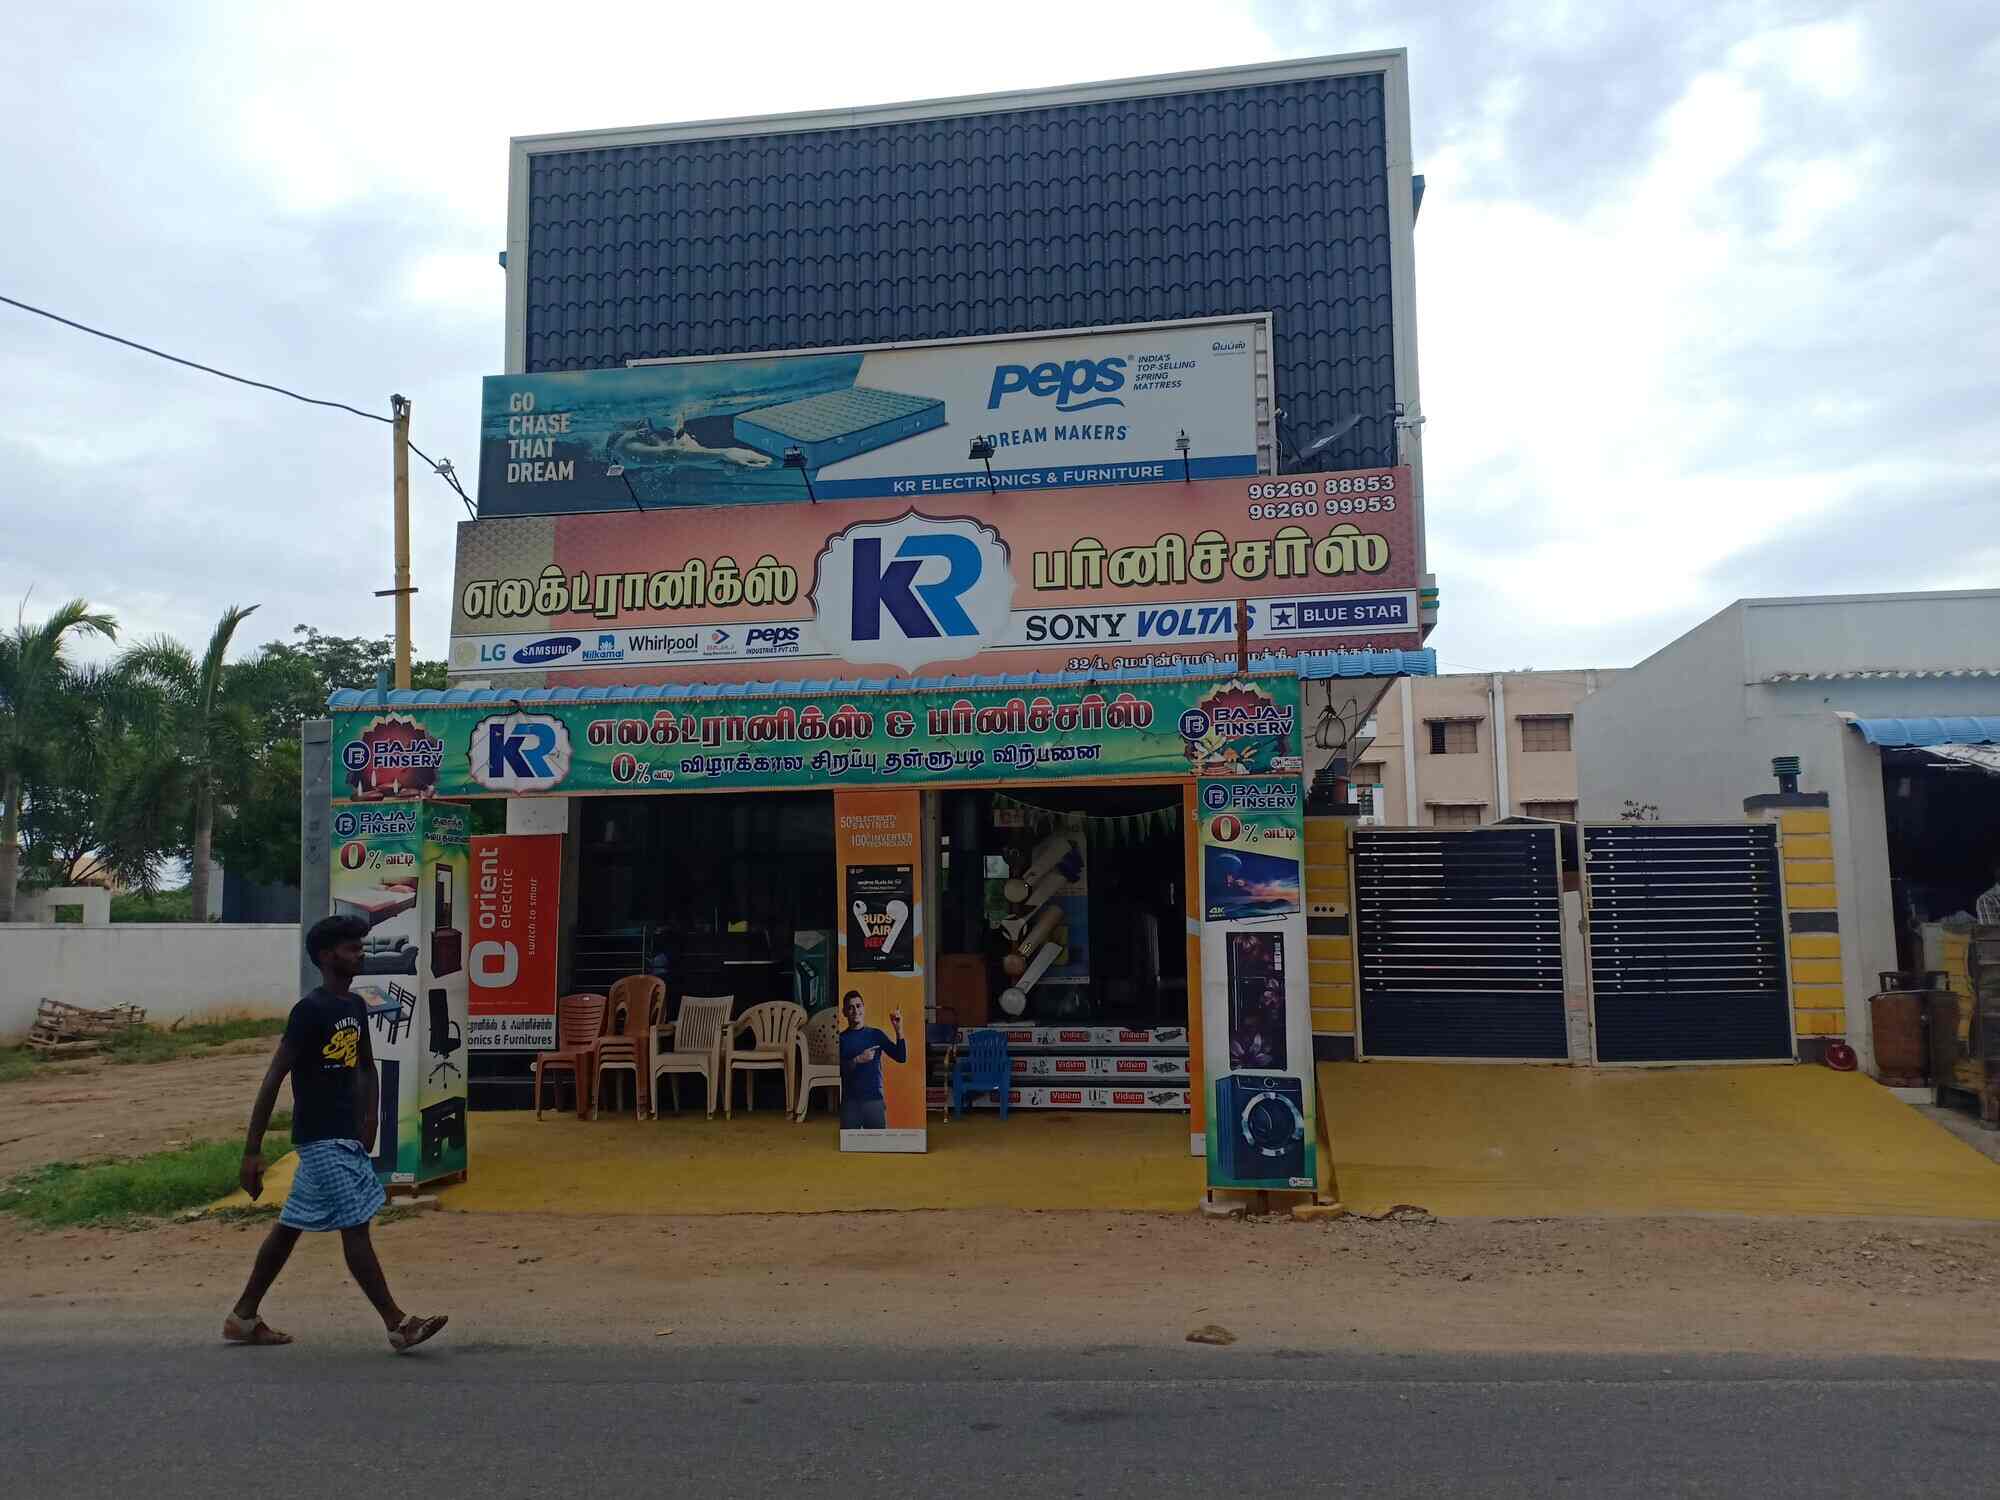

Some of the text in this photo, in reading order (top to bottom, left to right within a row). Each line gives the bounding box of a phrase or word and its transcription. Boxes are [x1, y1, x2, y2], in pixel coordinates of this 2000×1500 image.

[1136, 360, 1197, 372] TOP-SELLING
[1138, 353, 1171, 364] INDIA'S
[986, 354, 1127, 410] peps
[1133, 380, 1183, 391] MATTRESS
[1135, 371, 1169, 382] SPRING
[510, 392, 535, 411] GO
[508, 413, 570, 436] CHASE
[986, 424, 1128, 449] DREAM MAKERS
[508, 439, 555, 460] THAT
[506, 460, 575, 484] DREAM
[893, 464, 1164, 493] KR ELECTRONICS & FURNITURE
[1248, 475, 1395, 501] 96260 88853
[1249, 496, 1397, 520] 96260 99953
[851, 533, 982, 641] KR
[1303, 604, 1402, 623] BLUE STAR
[745, 626, 800, 646] peps
[1025, 613, 1128, 642] SONY
[480, 643, 506, 662] LG
[522, 644, 573, 657] SAMSUNG
[628, 633, 699, 654] Whirlpool
[746, 646, 777, 655] INDUSTRIES
[582, 649, 625, 660] Nilkamal
[1213, 705, 1294, 721] BAJAJ
[1213, 720, 1294, 736] FINSERV
[374, 740, 443, 754] BAJAJ
[488, 722, 556, 778] KR
[374, 753, 443, 768] FINSERV
[1232, 783, 1297, 796] BAJAJ
[1232, 796, 1297, 809] FINSERV
[360, 810, 417, 822] BAJAJ
[360, 822, 417, 834] FINSERV
[474, 847, 499, 929] orient
[499, 868, 513, 929] electric
[503, 1033, 553, 1045] Furnitures
